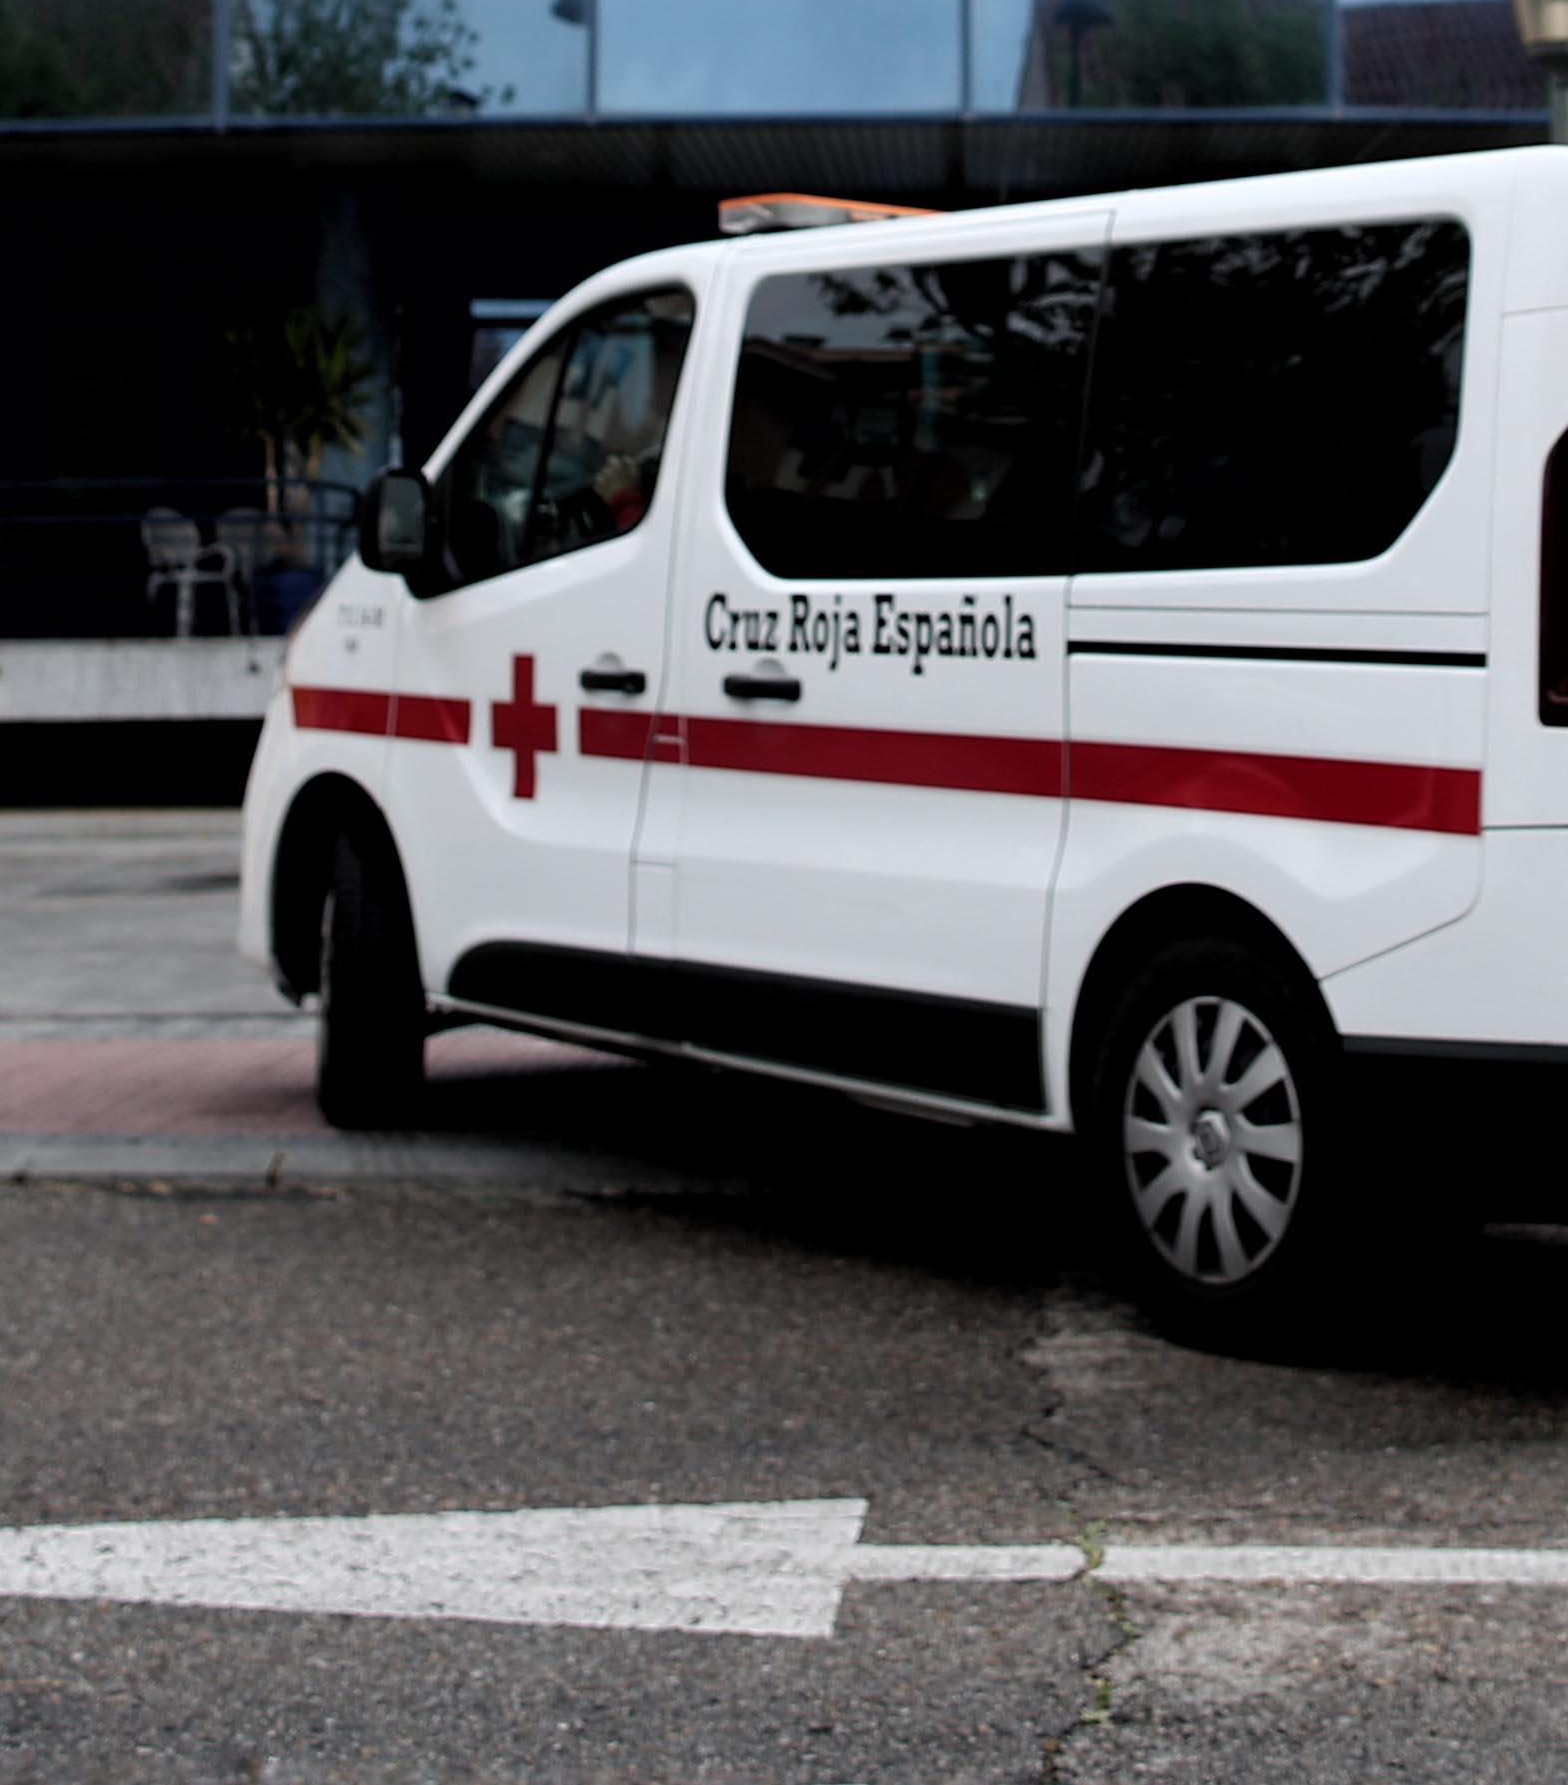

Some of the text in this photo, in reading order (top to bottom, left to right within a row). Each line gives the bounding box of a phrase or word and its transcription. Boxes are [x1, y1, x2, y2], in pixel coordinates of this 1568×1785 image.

[704, 593, 1037, 675] Cruz Roja Española
